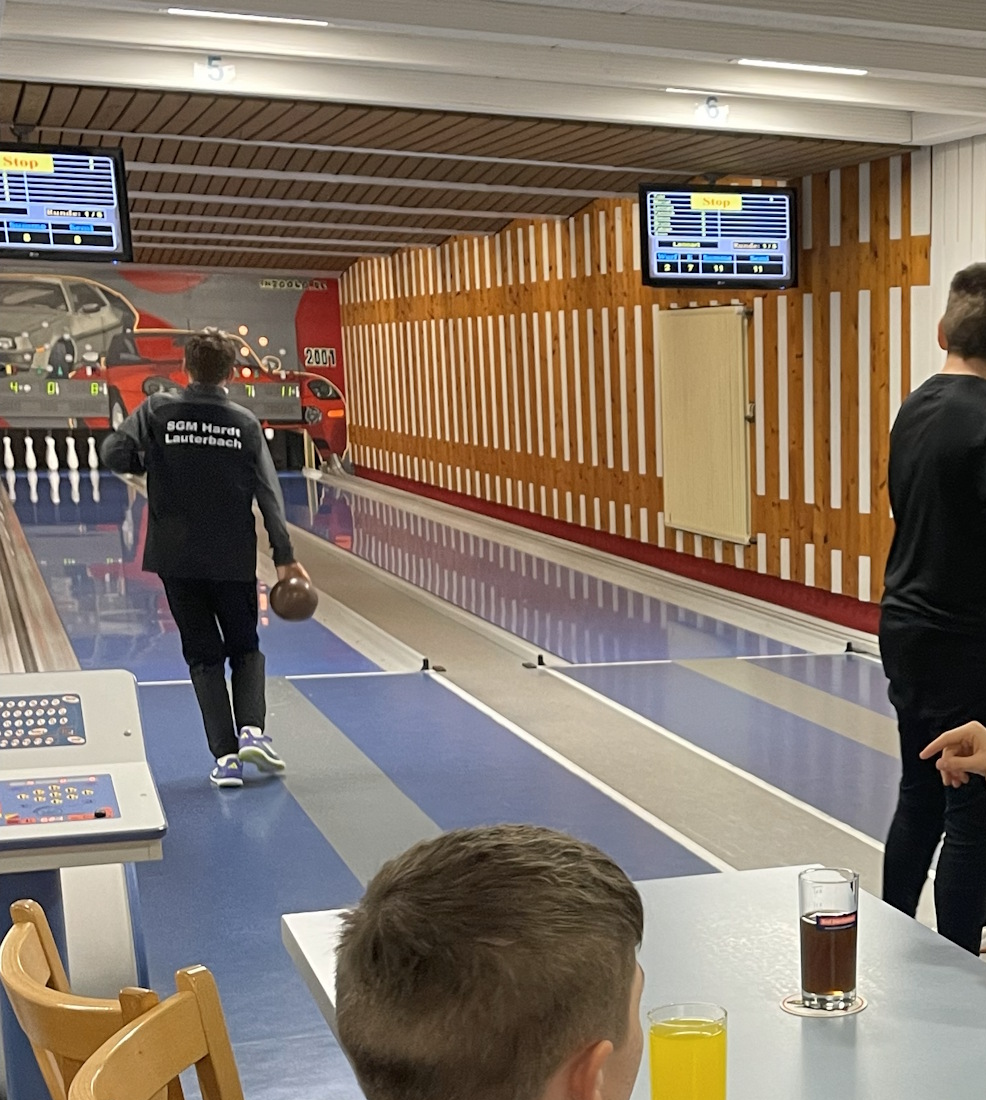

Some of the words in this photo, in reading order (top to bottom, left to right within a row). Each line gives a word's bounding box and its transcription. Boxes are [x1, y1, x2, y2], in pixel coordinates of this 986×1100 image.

[207, 55, 224, 81] 5
[705, 95, 720, 119] 6
[2, 156, 39, 170] Stop
[702, 196, 731, 209] Stop
[304, 347, 336, 367] 2001
[166, 420, 198, 432] SGM
[201, 422, 241, 438] Hardt
[164, 433, 242, 450] Lauterbach
